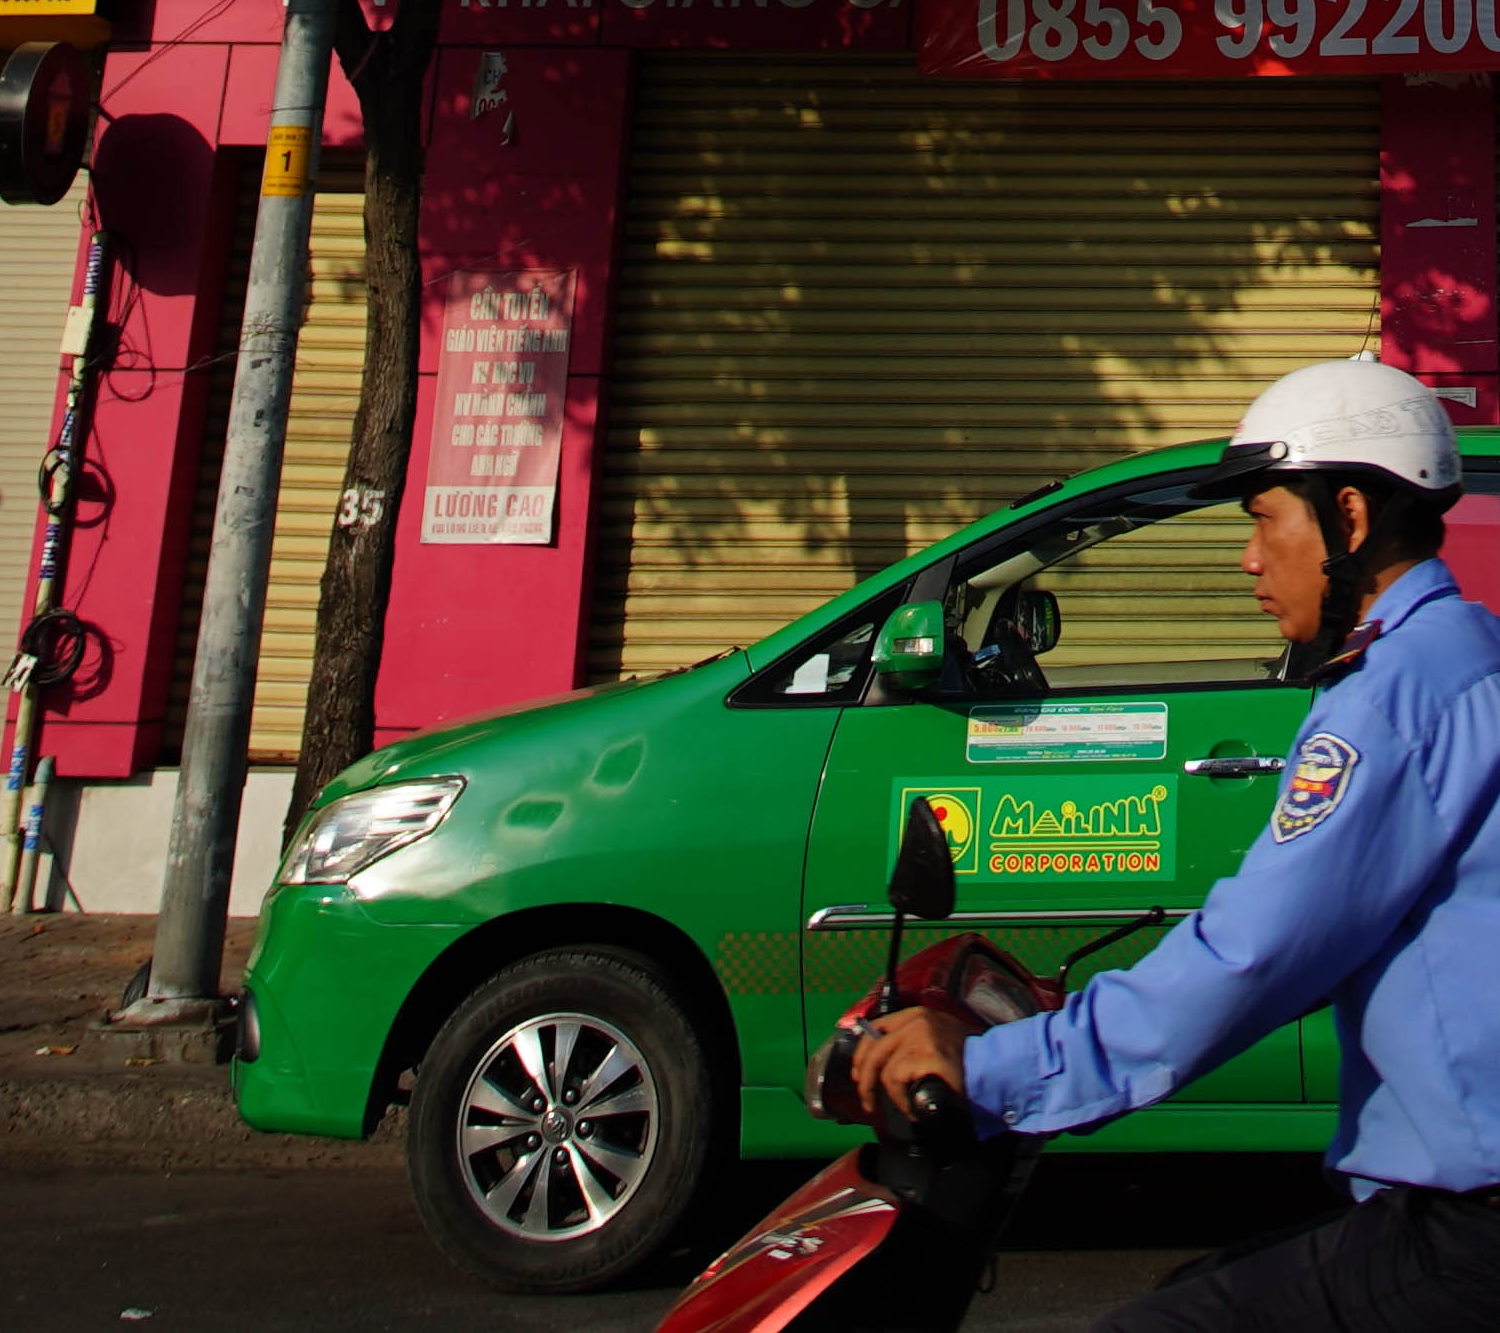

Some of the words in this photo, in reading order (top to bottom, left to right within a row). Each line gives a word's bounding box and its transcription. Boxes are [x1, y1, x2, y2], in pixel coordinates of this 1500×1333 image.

[470, 285, 501, 321] CẦN
[503, 283, 550, 321] TUYỂN
[446, 325, 475, 352] GIÁO
[476, 324, 504, 352] VIÊN
[506, 323, 542, 353] TIẾNG
[451, 423, 474, 447] CHO
[475, 420, 499, 447] CÁC
[338, 487, 387, 530] 35
[434, 491, 499, 519] LƯƠNG
[505, 492, 546, 519] CAO
[989, 852, 1162, 873] CORPORATION
